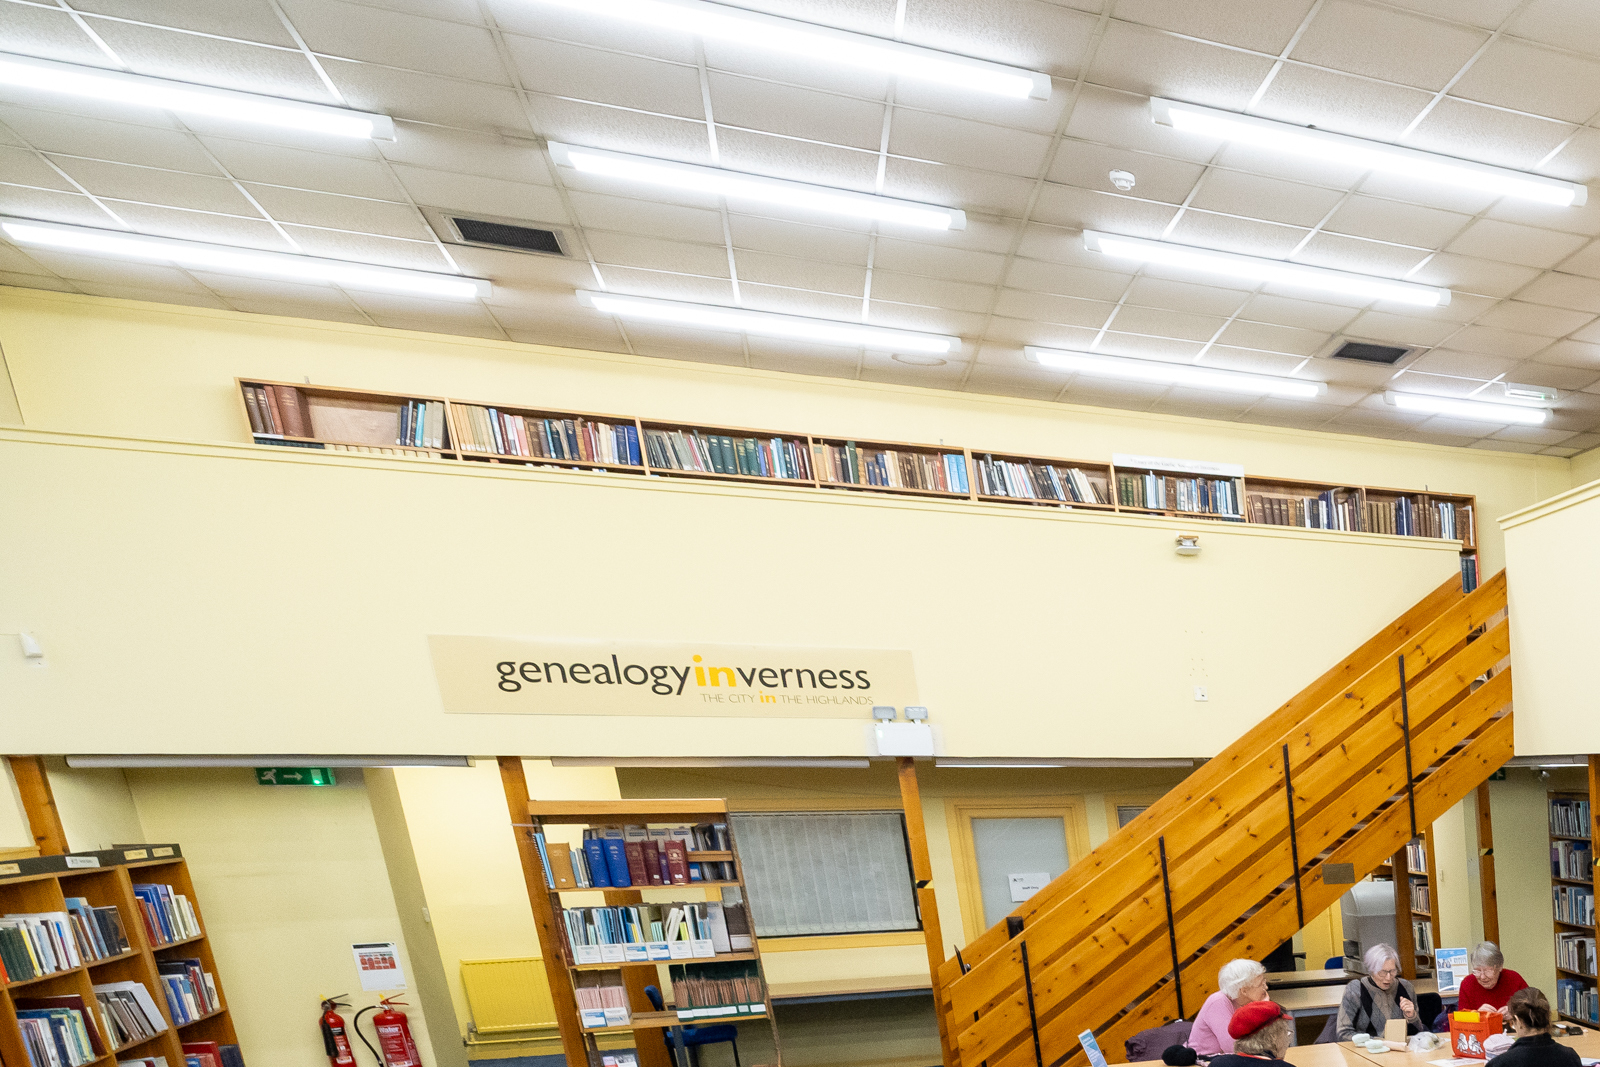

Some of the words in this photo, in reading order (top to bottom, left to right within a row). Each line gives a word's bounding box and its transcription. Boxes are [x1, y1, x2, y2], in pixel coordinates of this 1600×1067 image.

[702, 693, 725, 704] THE
[728, 693, 756, 704] CITY
[759, 690, 777, 704] in
[779, 694, 804, 705] THE
[806, 694, 875, 706] HIGHLANDS
